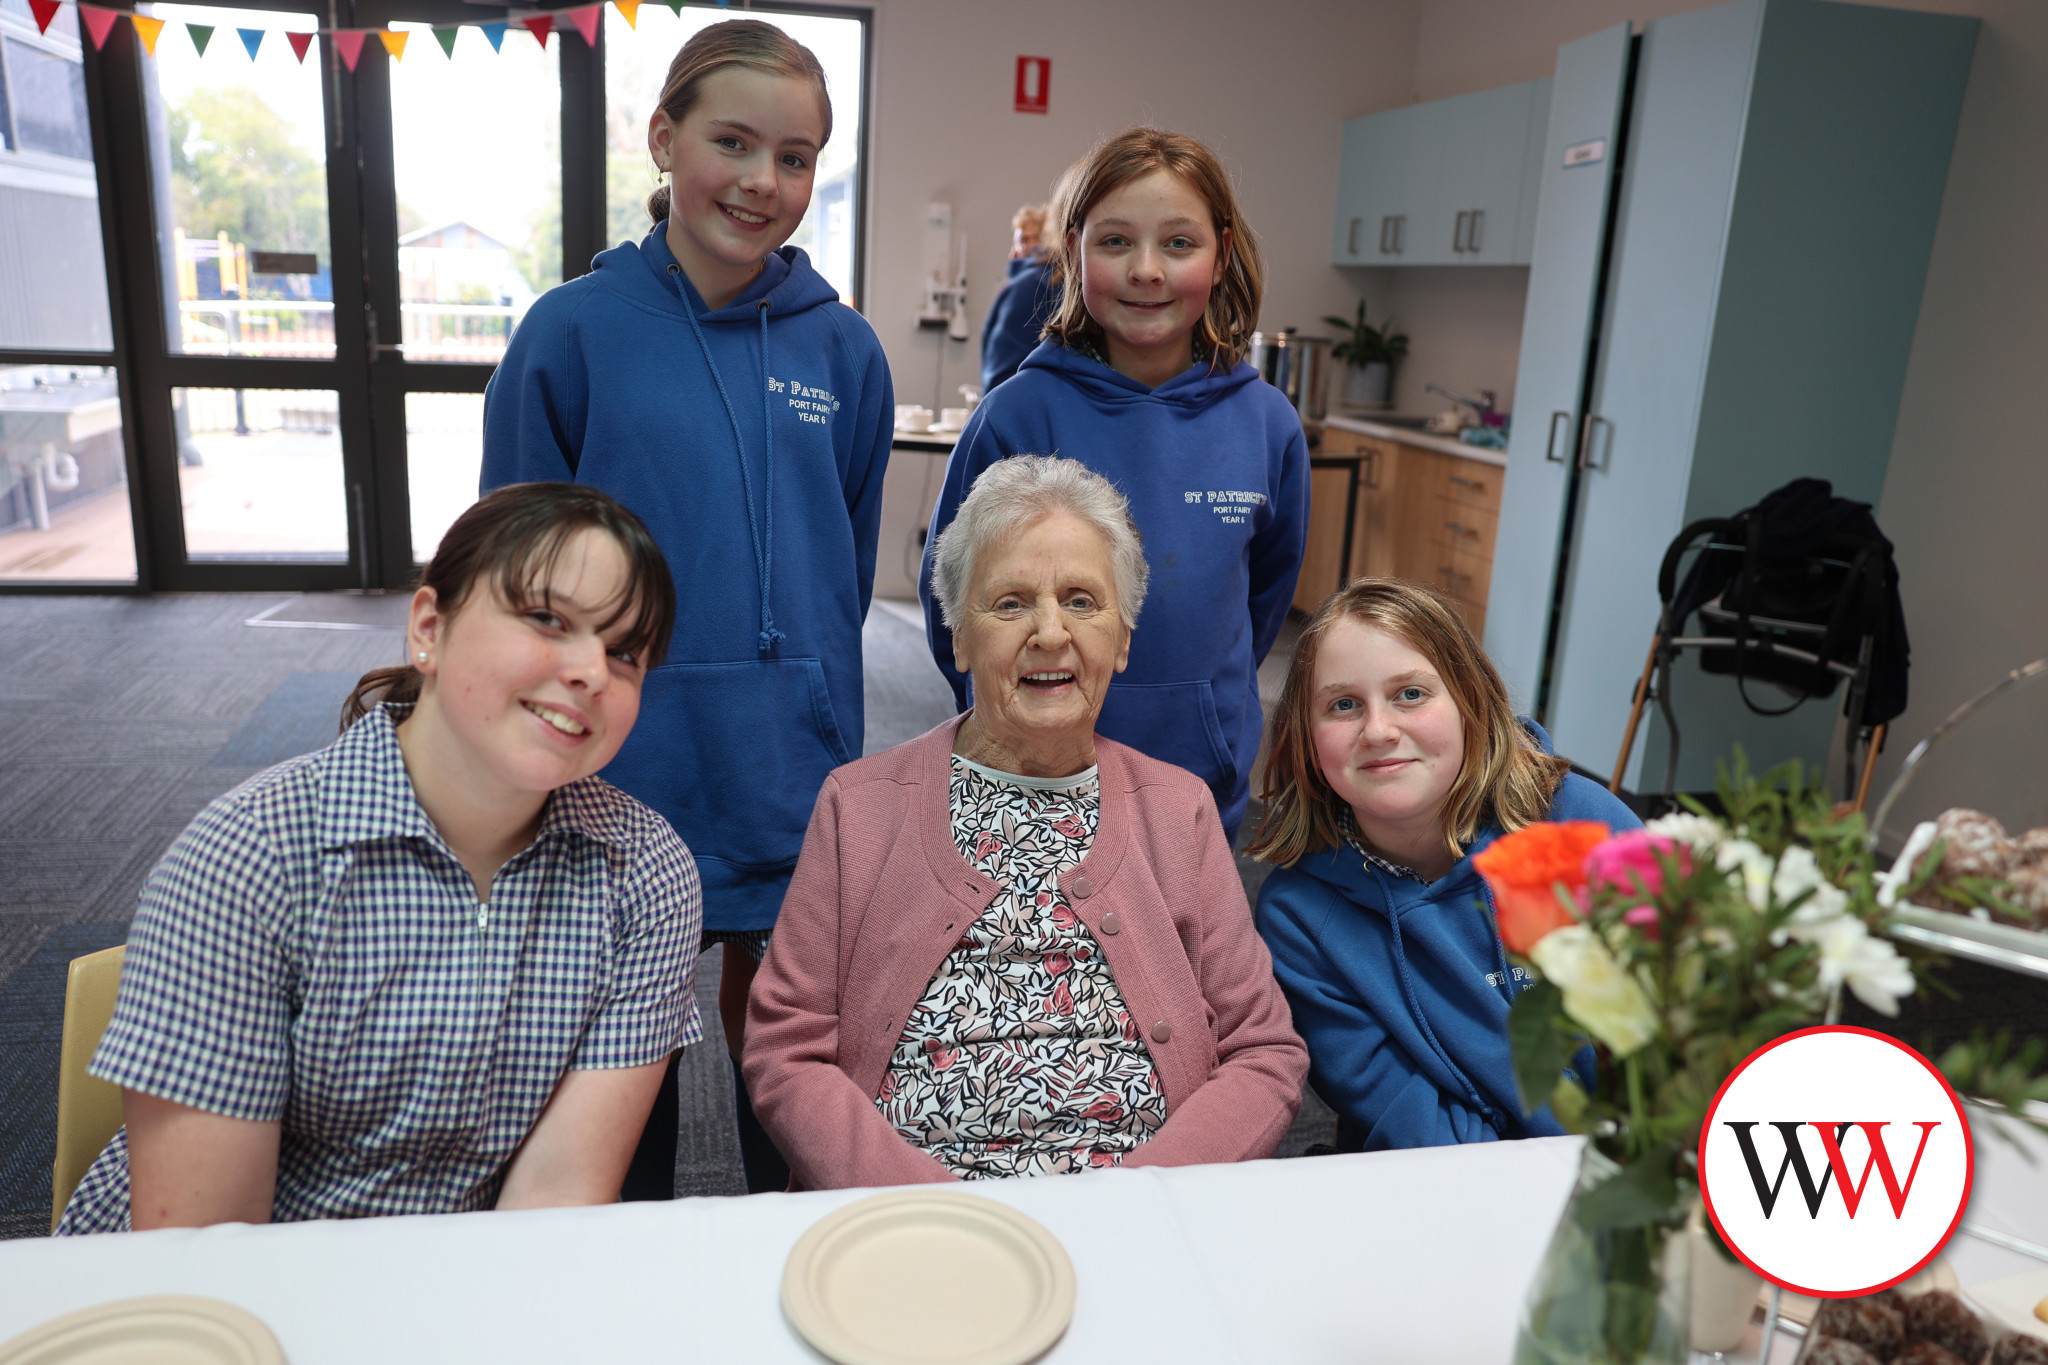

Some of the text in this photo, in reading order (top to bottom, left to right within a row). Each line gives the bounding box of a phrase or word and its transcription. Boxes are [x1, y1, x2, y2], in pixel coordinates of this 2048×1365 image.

[789, 399, 810, 410] PORT
[798, 412, 826, 425] YEAR 6
[1184, 491, 1203, 503] ST
[1213, 506, 1251, 514] PORT FAIRY
[1241, 516, 1246, 524] 6
